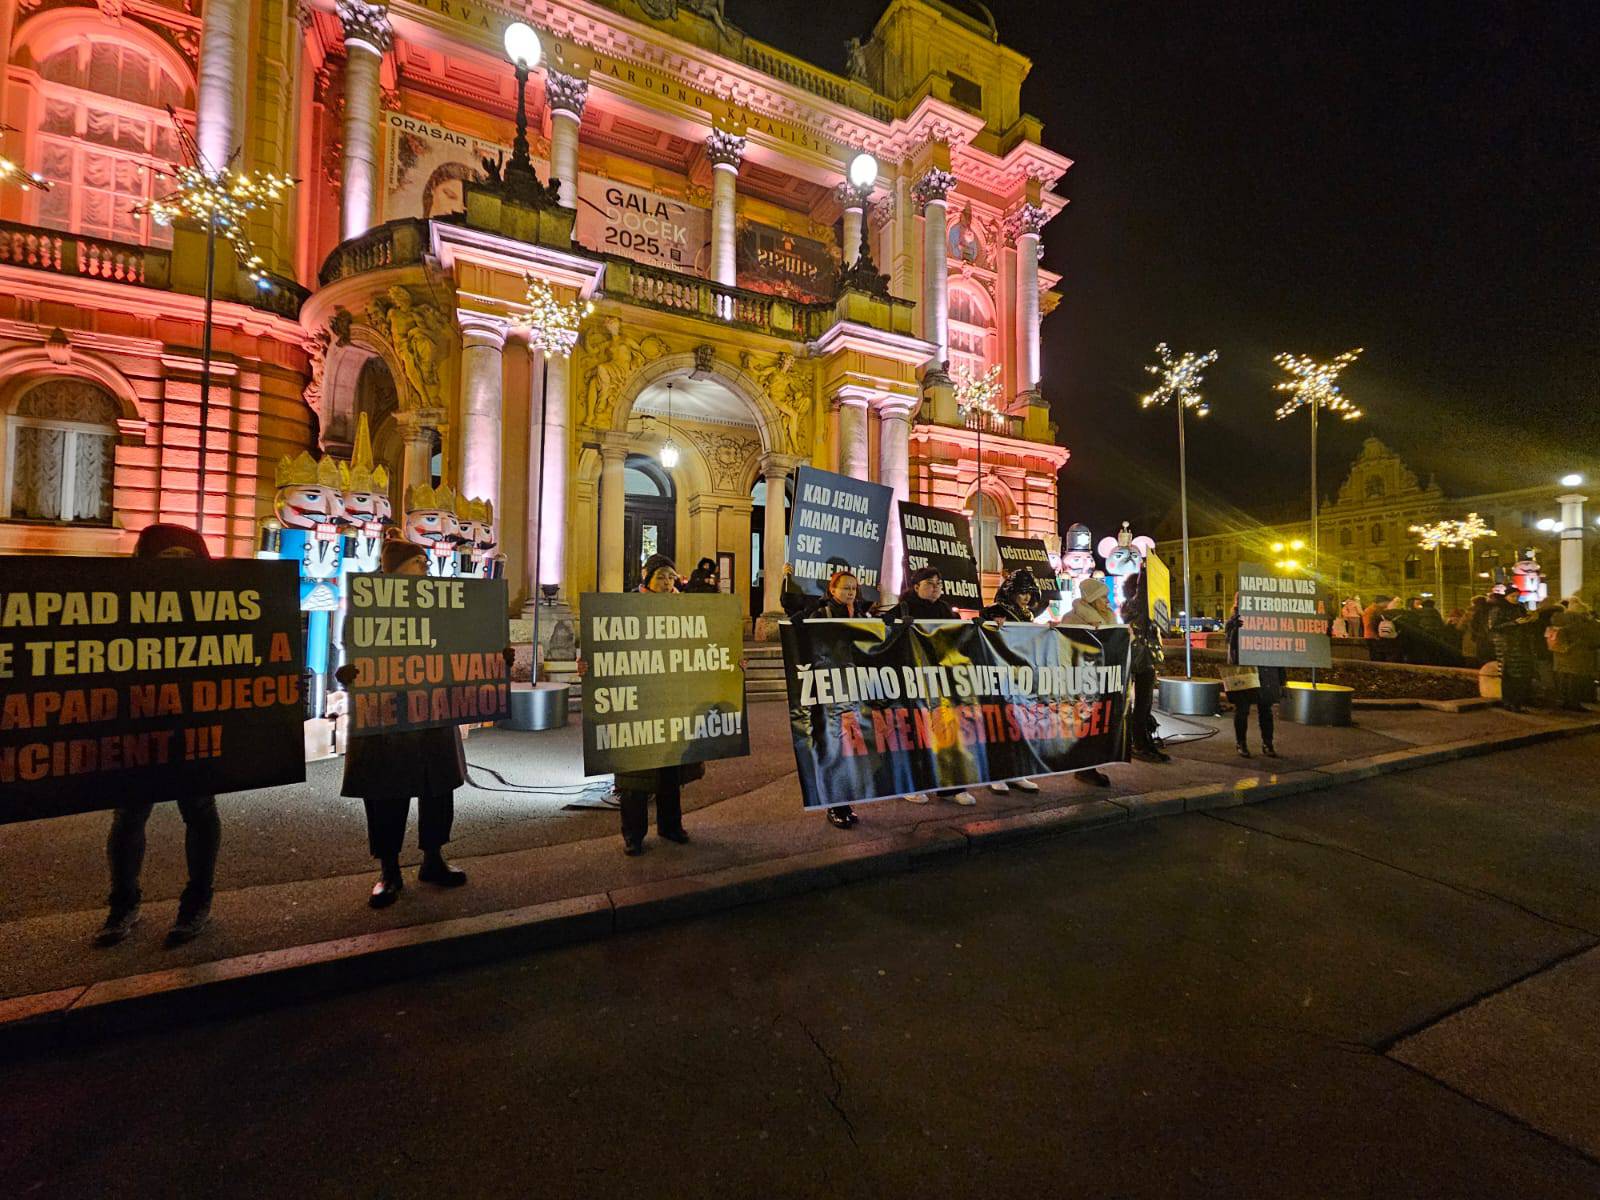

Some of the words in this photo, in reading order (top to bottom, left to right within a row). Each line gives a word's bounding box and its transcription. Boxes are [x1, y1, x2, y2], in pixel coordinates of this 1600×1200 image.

[593, 57, 703, 107] NARODNO
[727, 107, 832, 154] KAZALIŠTE
[606, 188, 670, 220] GALA
[605, 226, 665, 257] 2025.
[803, 484, 831, 506] KAD
[832, 490, 869, 515] JEDNA
[799, 509, 839, 534] MAMA
[841, 518, 880, 543] PLAČE,
[903, 514, 926, 530] KAD
[926, 519, 957, 537] JEDNA
[796, 533, 823, 555] SVE
[906, 535, 940, 553] MAMA
[940, 539, 971, 560] PLAČE,
[794, 559, 834, 581] MAME
[908, 555, 929, 571] SVE
[352, 577, 412, 609] SVE
[415, 580, 465, 609] STE
[945, 578, 979, 598] PLAČU!
[1240, 576, 1277, 592] NAPAD
[1279, 578, 1295, 594] NA
[1295, 580, 1316, 595] VAS
[0, 592, 118, 627] APAD
[130, 591, 183, 624] NA
[190, 590, 261, 622] VAS
[1241, 595, 1252, 611] JE
[1254, 596, 1316, 615] TERORIZAM,
[1317, 600, 1326, 615] A
[352, 617, 437, 649] UZELI,
[592, 616, 640, 641] KAD
[644, 615, 708, 640] JEDNA
[1240, 615, 1278, 632] NAPAD
[1279, 617, 1295, 632] NA
[1296, 619, 1329, 634] DJECU
[25, 633, 262, 677] TERORIZAM,
[269, 632, 292, 662] A
[593, 649, 665, 677] MAMA
[669, 643, 735, 675] PLAČE,
[1240, 636, 1292, 652] INCIDENT
[353, 652, 444, 688] DJECU
[450, 652, 506, 681] VAM
[797, 664, 901, 706] ŽELIMO
[902, 665, 951, 699] BITI
[952, 664, 1032, 696] SVJETLO
[0, 687, 118, 731] APAD
[130, 683, 183, 720] NA
[192, 674, 299, 713] DJECU
[355, 691, 398, 729] NE
[407, 683, 507, 721] DAMO!
[594, 685, 638, 714] SVE
[596, 720, 665, 751] MAME
[669, 708, 742, 743] PLAČU!
[841, 710, 869, 757] A
[871, 707, 915, 754] NE
[0, 728, 175, 784] NCIDENT
[184, 724, 223, 761] !!!
